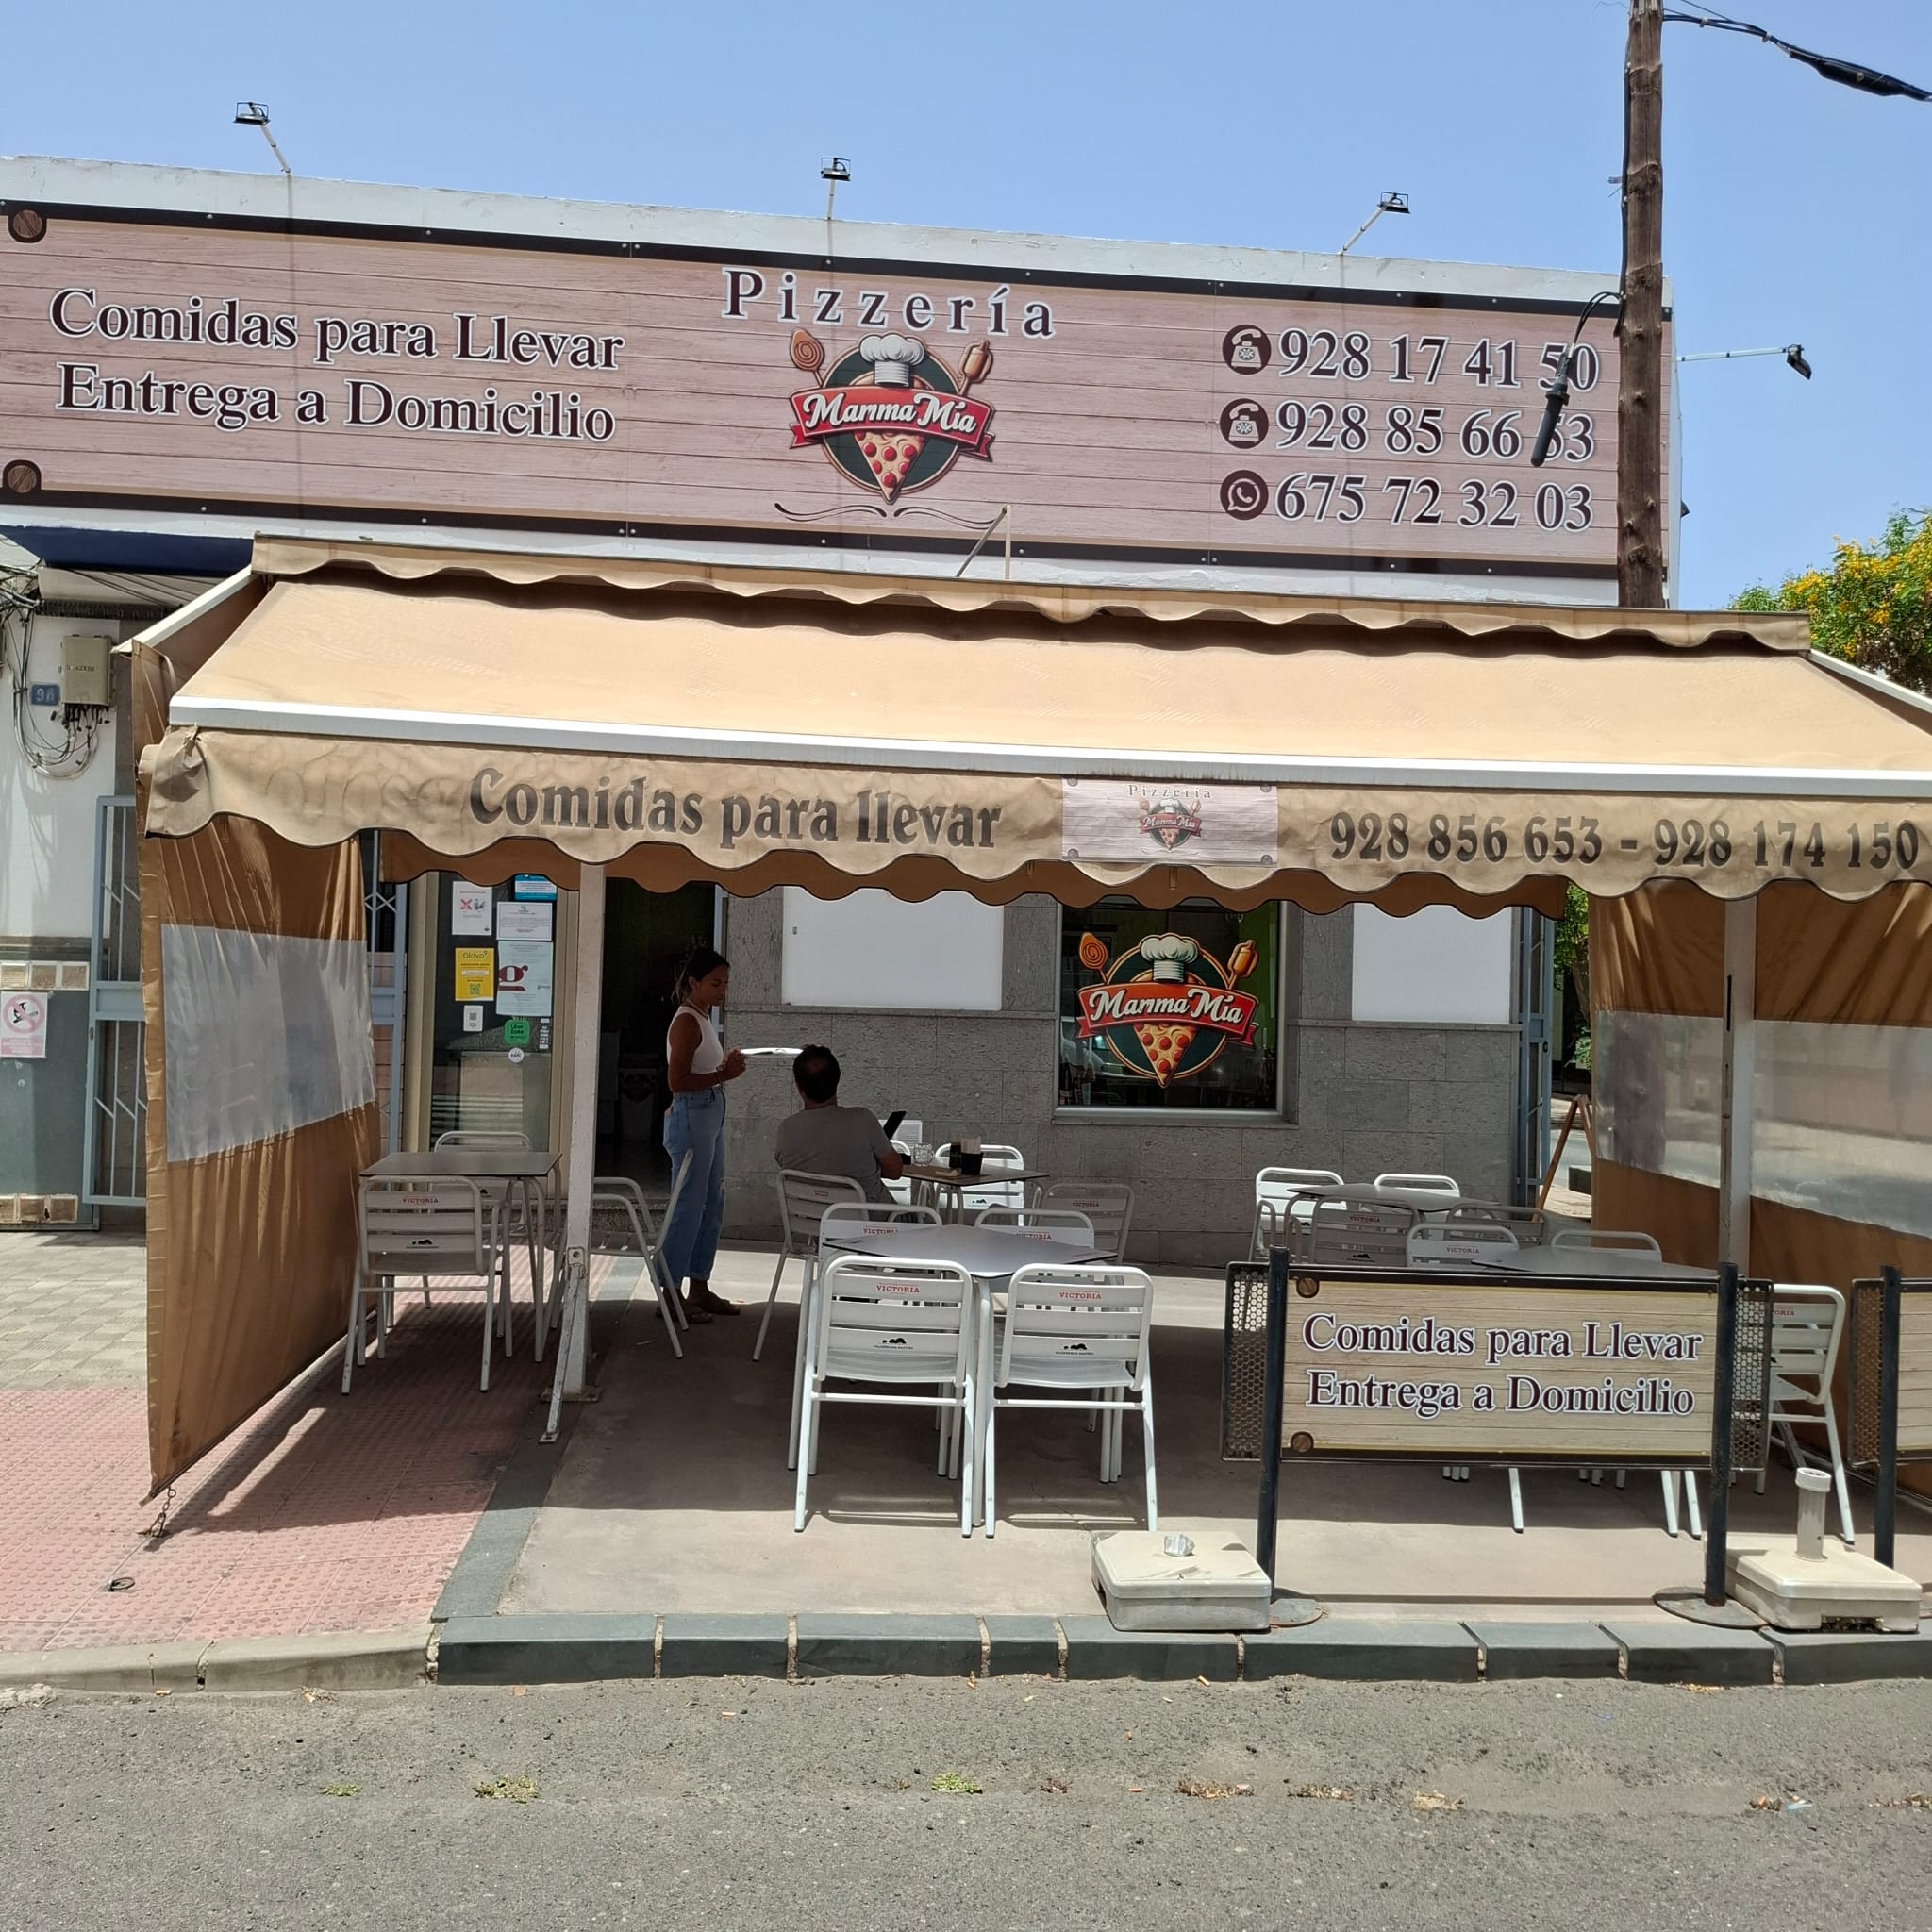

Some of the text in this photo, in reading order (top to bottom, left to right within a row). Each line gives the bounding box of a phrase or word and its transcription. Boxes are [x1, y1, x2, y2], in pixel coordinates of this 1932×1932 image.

[50, 288, 625, 369] Comidas para Llevar
[722, 266, 1056, 340] Pizzería
[1278, 327, 1599, 392] 928 17 41 50
[56, 361, 616, 441] Entrega a Domicilio
[803, 392, 916, 428] Mamma
[1276, 399, 1370, 453] 928
[1384, 404, 1444, 457] 85
[1460, 409, 1522, 459] 66
[1275, 472, 1592, 532] 675 72 32 03
[470, 766, 1003, 850] Comidas para llevar
[1330, 811, 1409, 862] 928
[1428, 813, 1507, 865] 856
[1524, 815, 1603, 866] 653
[1654, 818, 1732, 869] 928
[1752, 820, 1826, 869] 174
[1847, 821, 1919, 871] 150
[1089, 989, 1190, 1021] Mamma
[876, 1285, 920, 1293] VICTORIA
[1059, 1291, 1102, 1300] VICTORIA
[1302, 1312, 1704, 1365] Comidas para Llevar
[1306, 1369, 1695, 1418] Entrega a Domicilio
